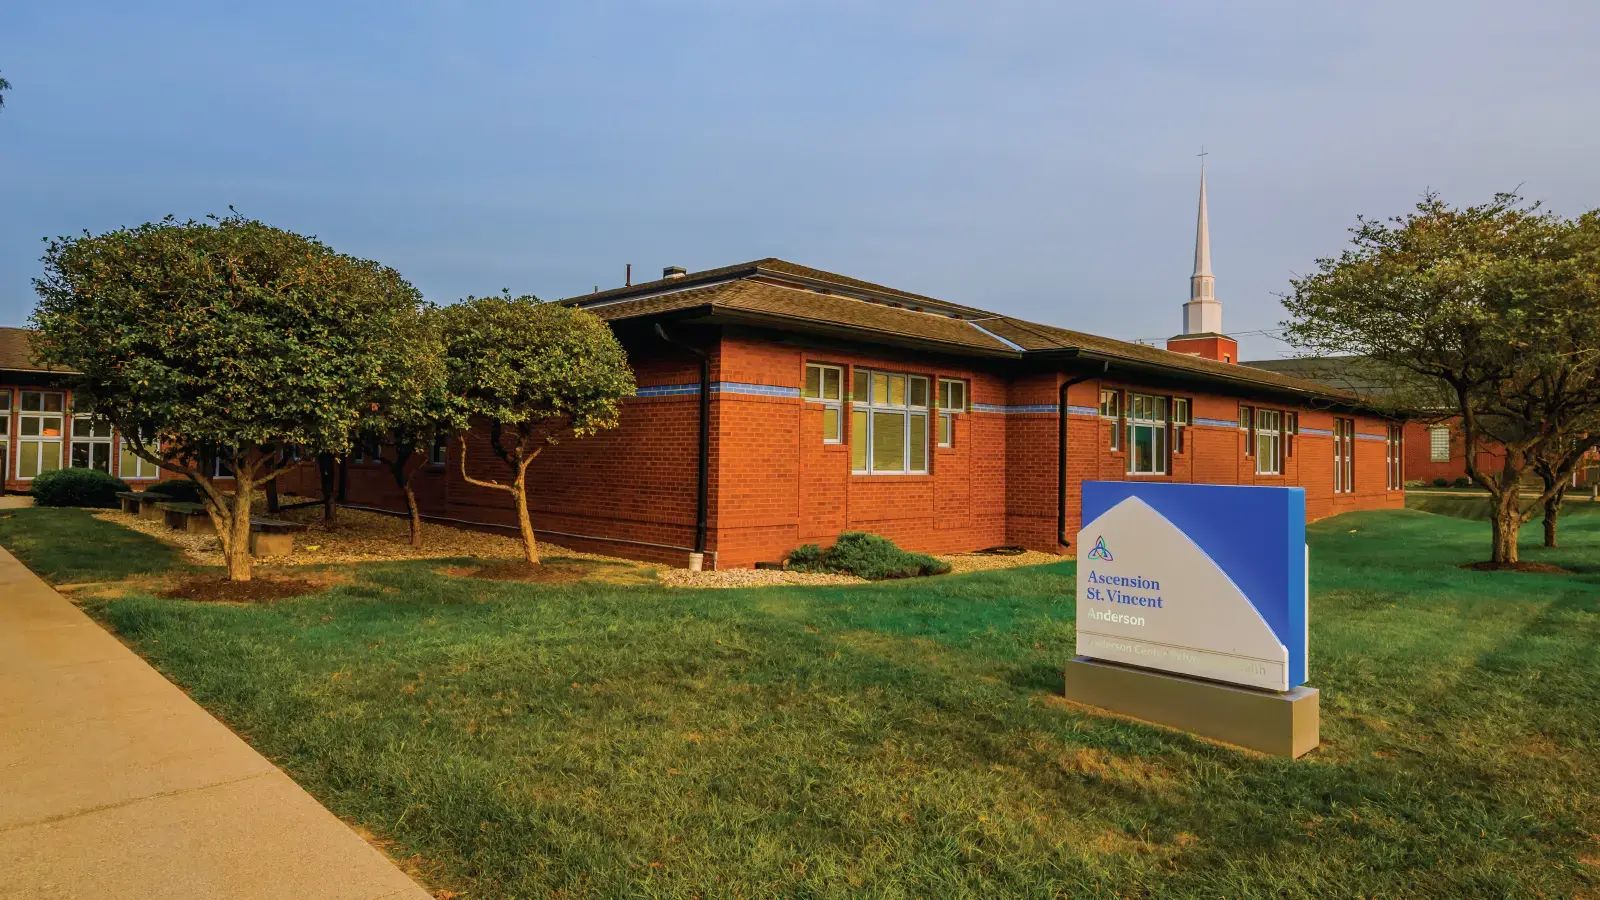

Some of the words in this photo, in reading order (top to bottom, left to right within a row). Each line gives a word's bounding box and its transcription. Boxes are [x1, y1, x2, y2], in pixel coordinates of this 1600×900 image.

[1088, 570, 1160, 590] Ascension
[1087, 587, 1105, 601] St.
[1106, 588, 1164, 608] Vincent
[1087, 607, 1145, 626] Anderson
